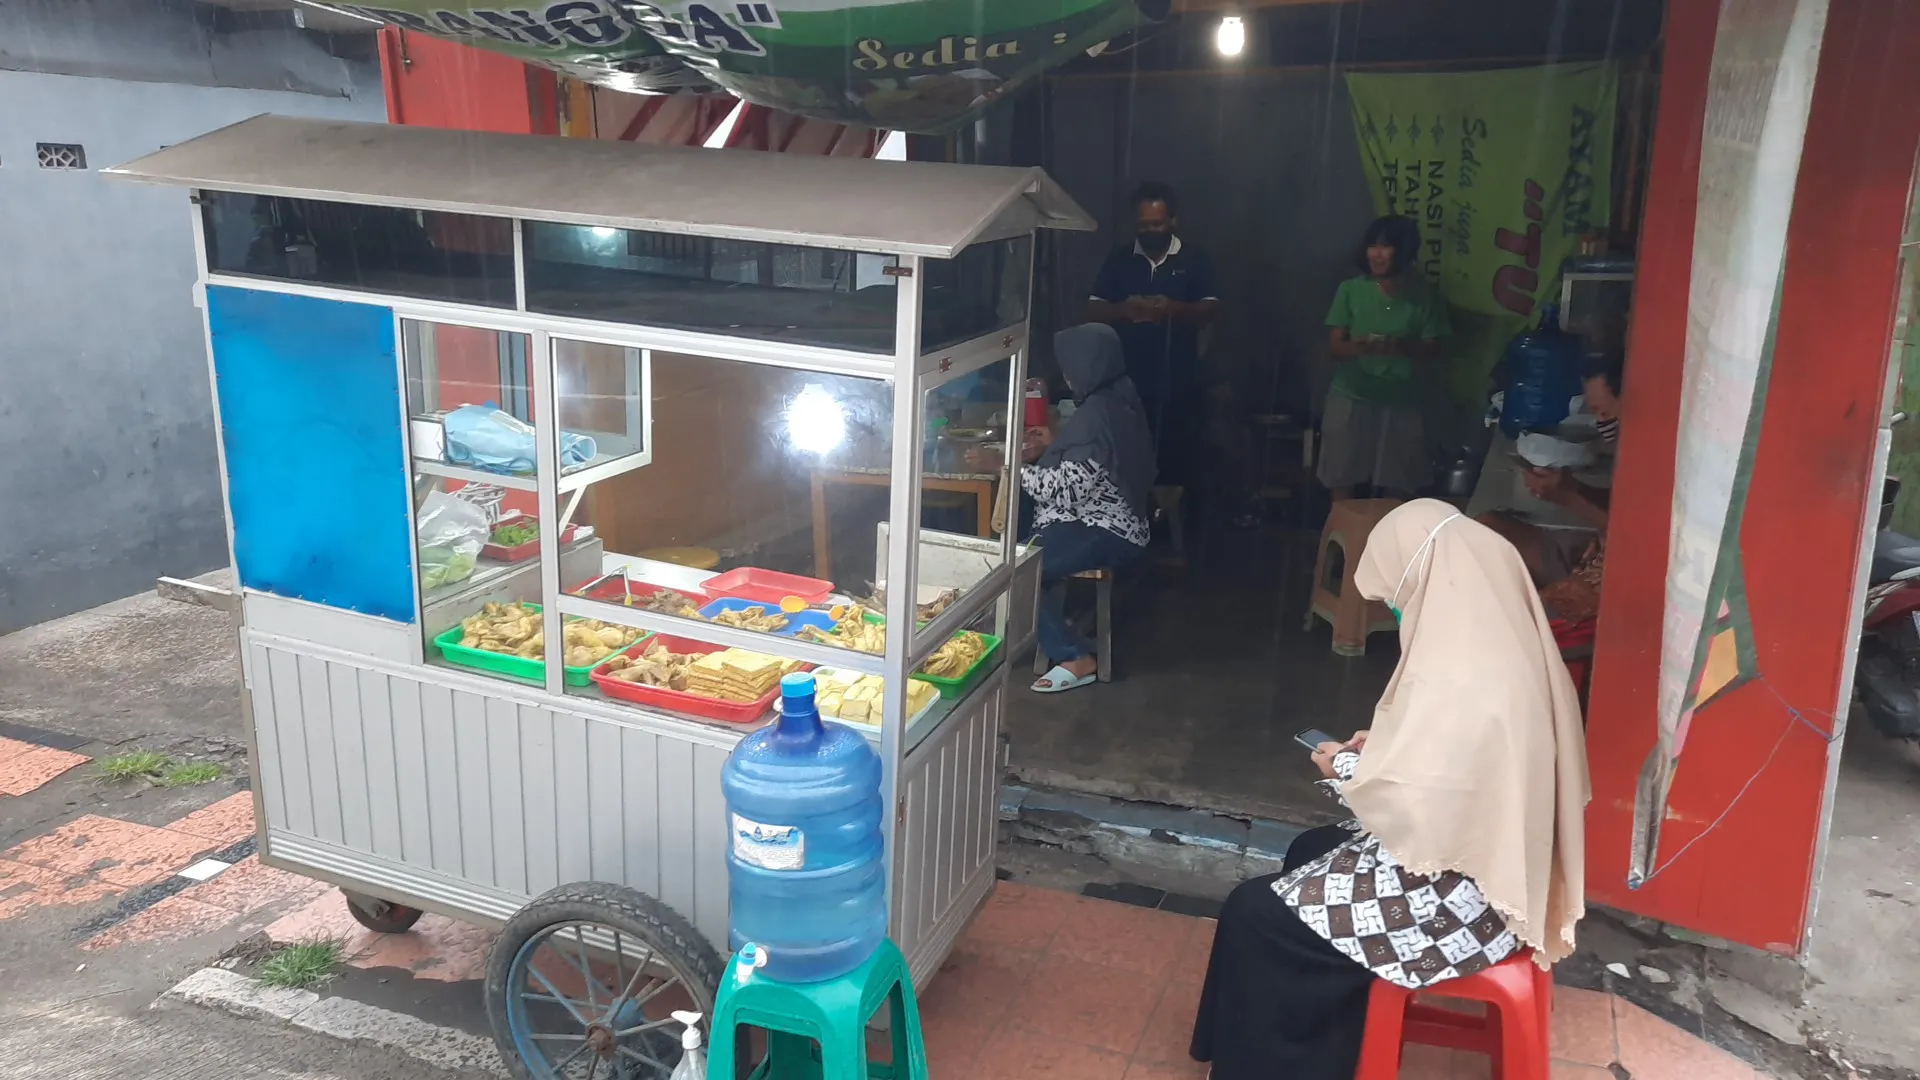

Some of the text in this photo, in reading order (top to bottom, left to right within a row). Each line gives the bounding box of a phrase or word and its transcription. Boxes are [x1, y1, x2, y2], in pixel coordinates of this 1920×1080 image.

[852, 36, 1020, 70] Sedia
[1457, 115, 1487, 190] Sedia
[1563, 104, 1597, 237] AYAM
[1405, 159, 1421, 222] TAH
[1427, 160, 1445, 229] NASI
